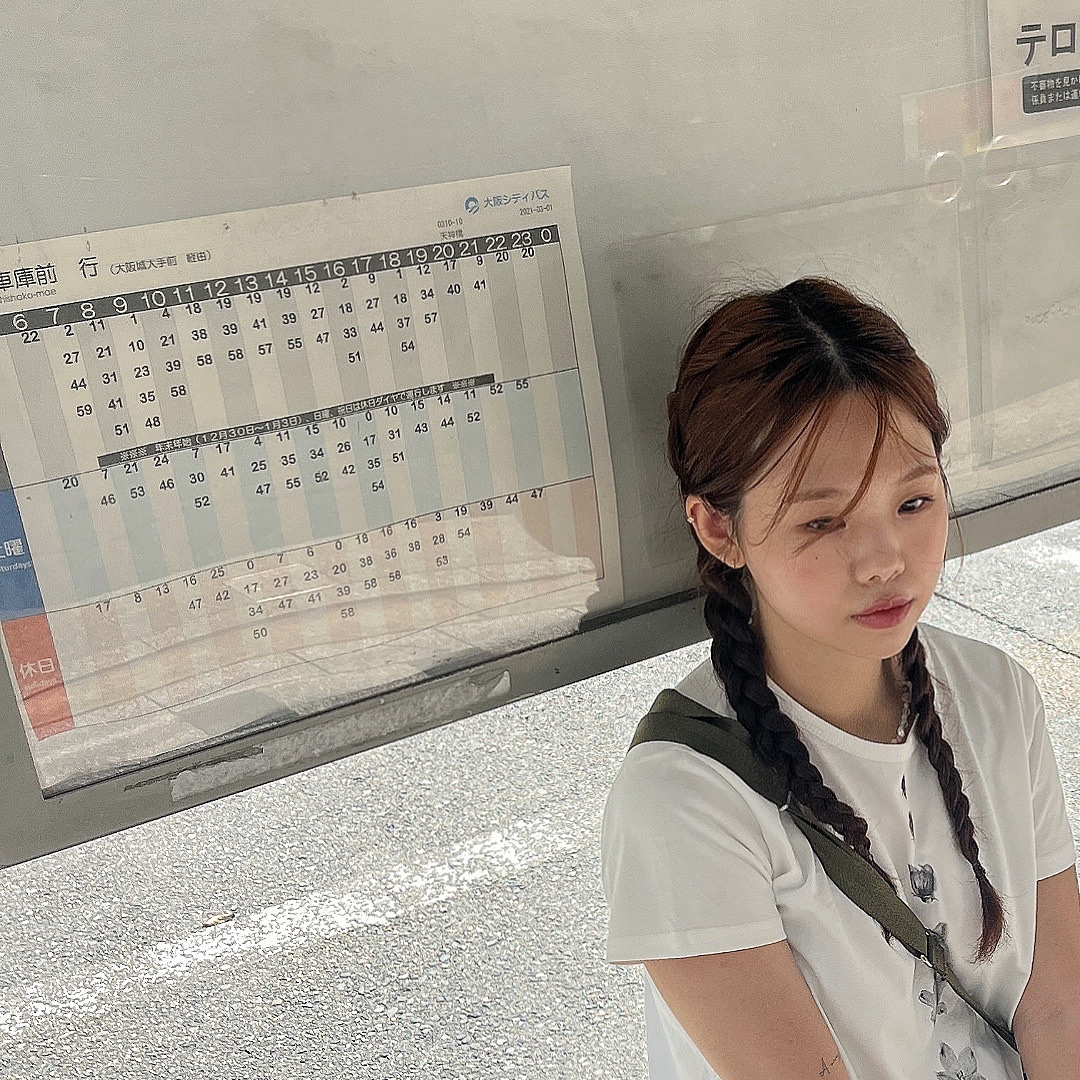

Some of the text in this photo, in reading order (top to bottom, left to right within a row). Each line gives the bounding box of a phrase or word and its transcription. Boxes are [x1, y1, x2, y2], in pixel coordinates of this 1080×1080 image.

[484, 189, 549, 208] 大阪シティバス
[520, 204, 553, 216] 2021-03-01
[437, 218, 463, 228] 0310-10
[13, 228, 551, 331] 6 7 8 9 10 11 12 13 14 15 16 17 18 19 20 21 22 23 0
[79, 256, 98, 278] 行
[21, 247, 534, 344] 22 2 11 1 4 18 19 19 19 12 2 9 1 12 17 9 20 20
[64, 279, 486, 364] 27 21 10 21 38 39 41 39 27 18 27 18 34 40 41
[71, 313, 437, 390] 44 31 23 39 58 58 57 55 47 33 44 37 57
[77, 341, 415, 417] 59 41 35 58 51 54
[62, 380, 528, 490] 20 7 21 24 7 17 4 11 15 10 0 10 15 14 11 52 55
[114, 417, 160, 436] 51 48
[101, 412, 480, 506] 46 53 46 30 41 25 35 34 26 17 31 43 44 52
[195, 452, 405, 508] 52 47 55 52 42 35 51
[372, 481, 384, 492] 54
[134, 489, 543, 604] 8 13 16 25 6 0 18 16 16 3 19 39 44 47
[385, 528, 470, 559] 36 38 28 54
[0, 561, 32, 572] turdays
[20, 657, 55, 680] 休日
